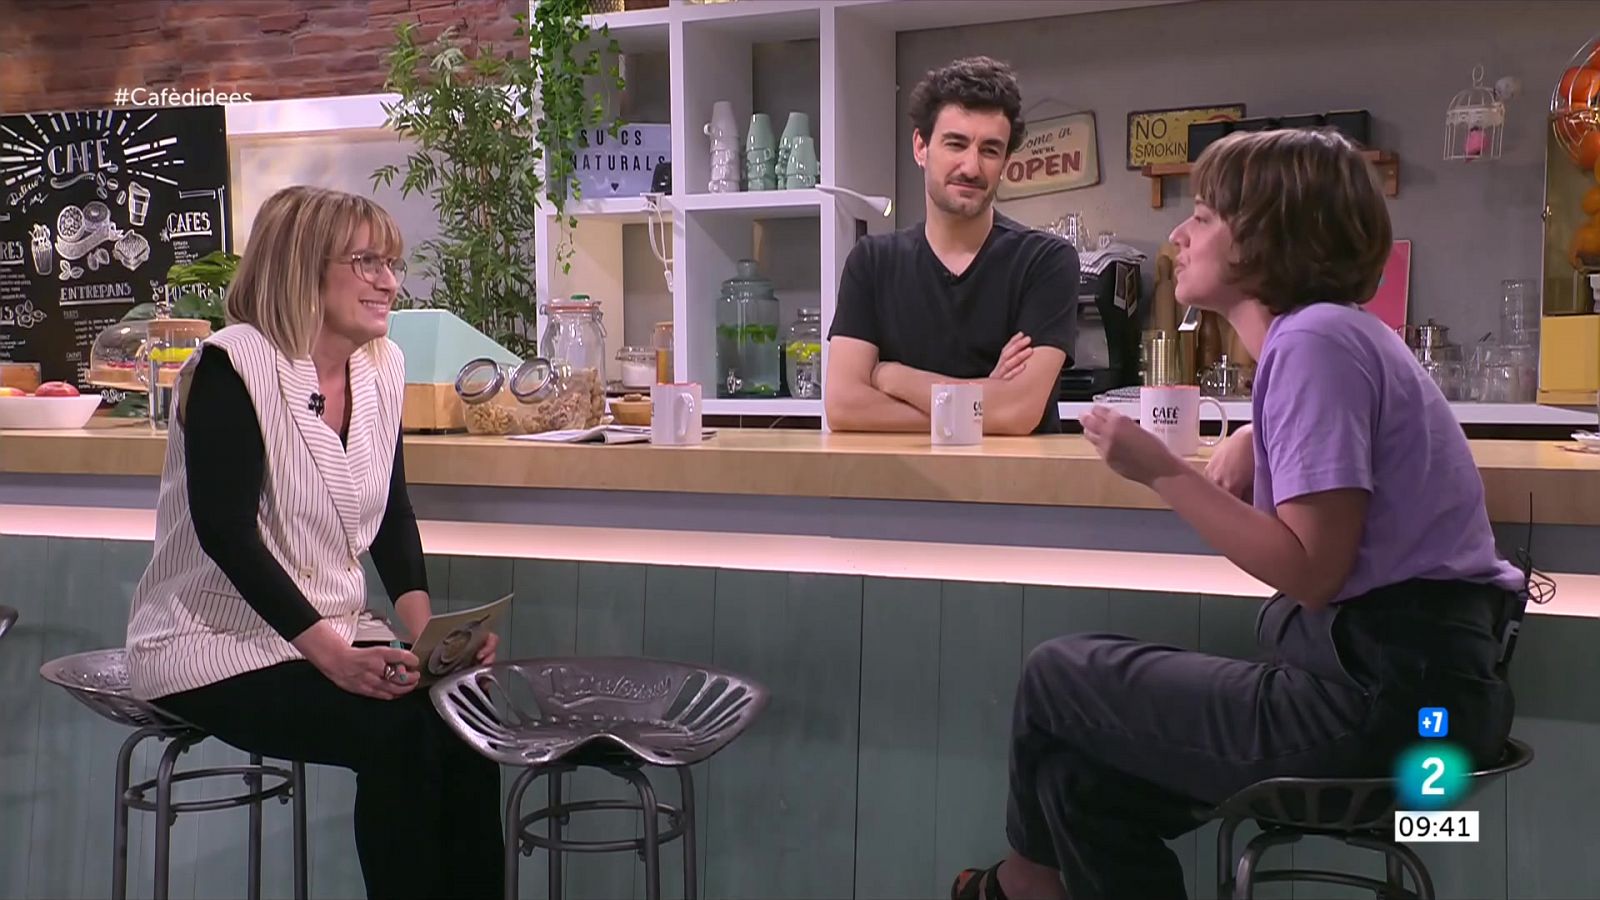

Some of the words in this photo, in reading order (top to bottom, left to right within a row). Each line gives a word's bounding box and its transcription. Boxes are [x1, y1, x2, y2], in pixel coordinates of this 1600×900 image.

[580, 129, 642, 146] SUCS
[1136, 118, 1167, 140] NO
[1135, 142, 1187, 158] SMOKIN
[1006, 150, 1081, 182] OPEN
[167, 212, 211, 233] CAFES
[60, 282, 132, 300] ENTREPANS
